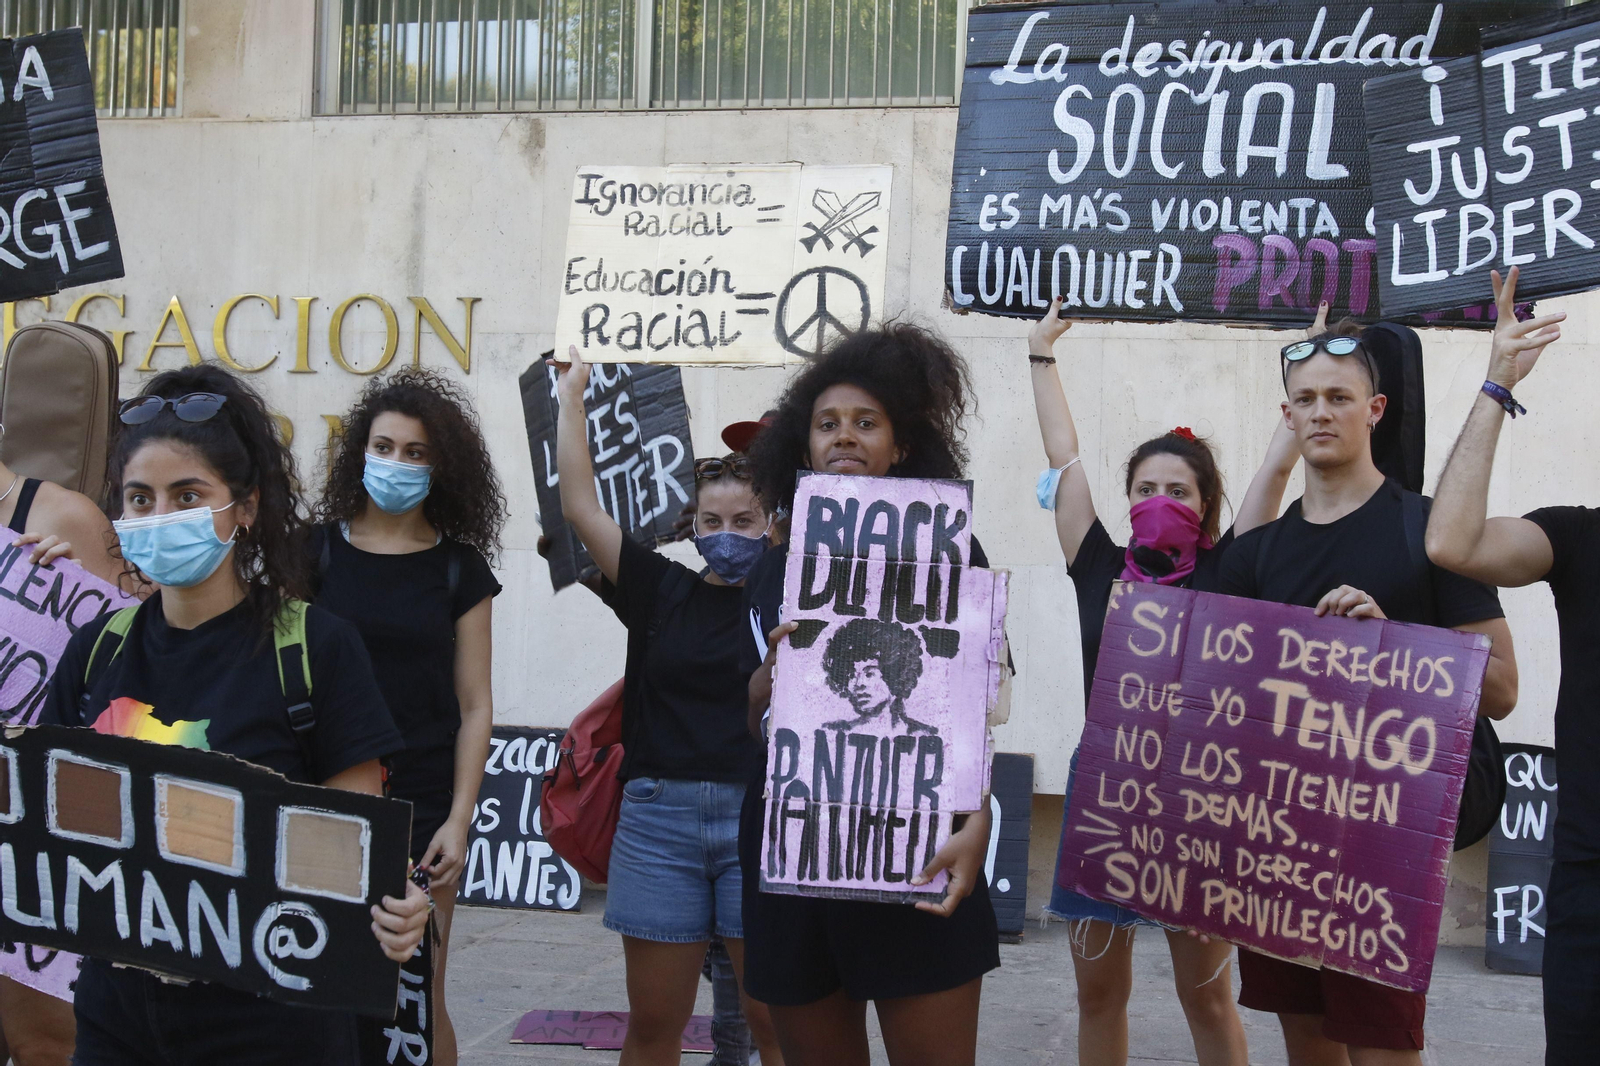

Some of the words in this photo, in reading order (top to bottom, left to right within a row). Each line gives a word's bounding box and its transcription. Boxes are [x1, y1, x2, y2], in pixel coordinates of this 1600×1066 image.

[988, 11, 1070, 85] La
[1098, 3, 1443, 104] desigualdad
[1047, 82, 1349, 184] SOCIAL
[1403, 107, 1600, 205] JUST
[575, 173, 756, 216] Ignorancia
[624, 209, 733, 237] Racial
[979, 193, 1020, 231] ES
[1039, 188, 1131, 232] MÁS
[1151, 197, 1339, 237] VIOLENTA
[1391, 178, 1600, 286] LIBER
[564, 255, 736, 297] Educación
[952, 241, 1185, 313] CUALQUIER
[1212, 234, 1377, 316] PROT
[580, 303, 742, 352] Racial
[798, 495, 968, 624] BLACK
[1201, 622, 1255, 664] LOS
[1277, 628, 1455, 697] DERECHOS
[1118, 672, 1184, 717] QUE
[1206, 686, 1246, 728] YO
[1258, 678, 1437, 776] TENGO
[1098, 772, 1163, 817] LOS
[1114, 724, 1163, 770] NO
[1180, 741, 1243, 785] LOS
[1259, 759, 1400, 825] TIENEN
[456, 837, 581, 910] ANTES
[1105, 851, 1187, 914] SON
[1131, 824, 1165, 855] NO
[1175, 833, 1221, 868] SON
